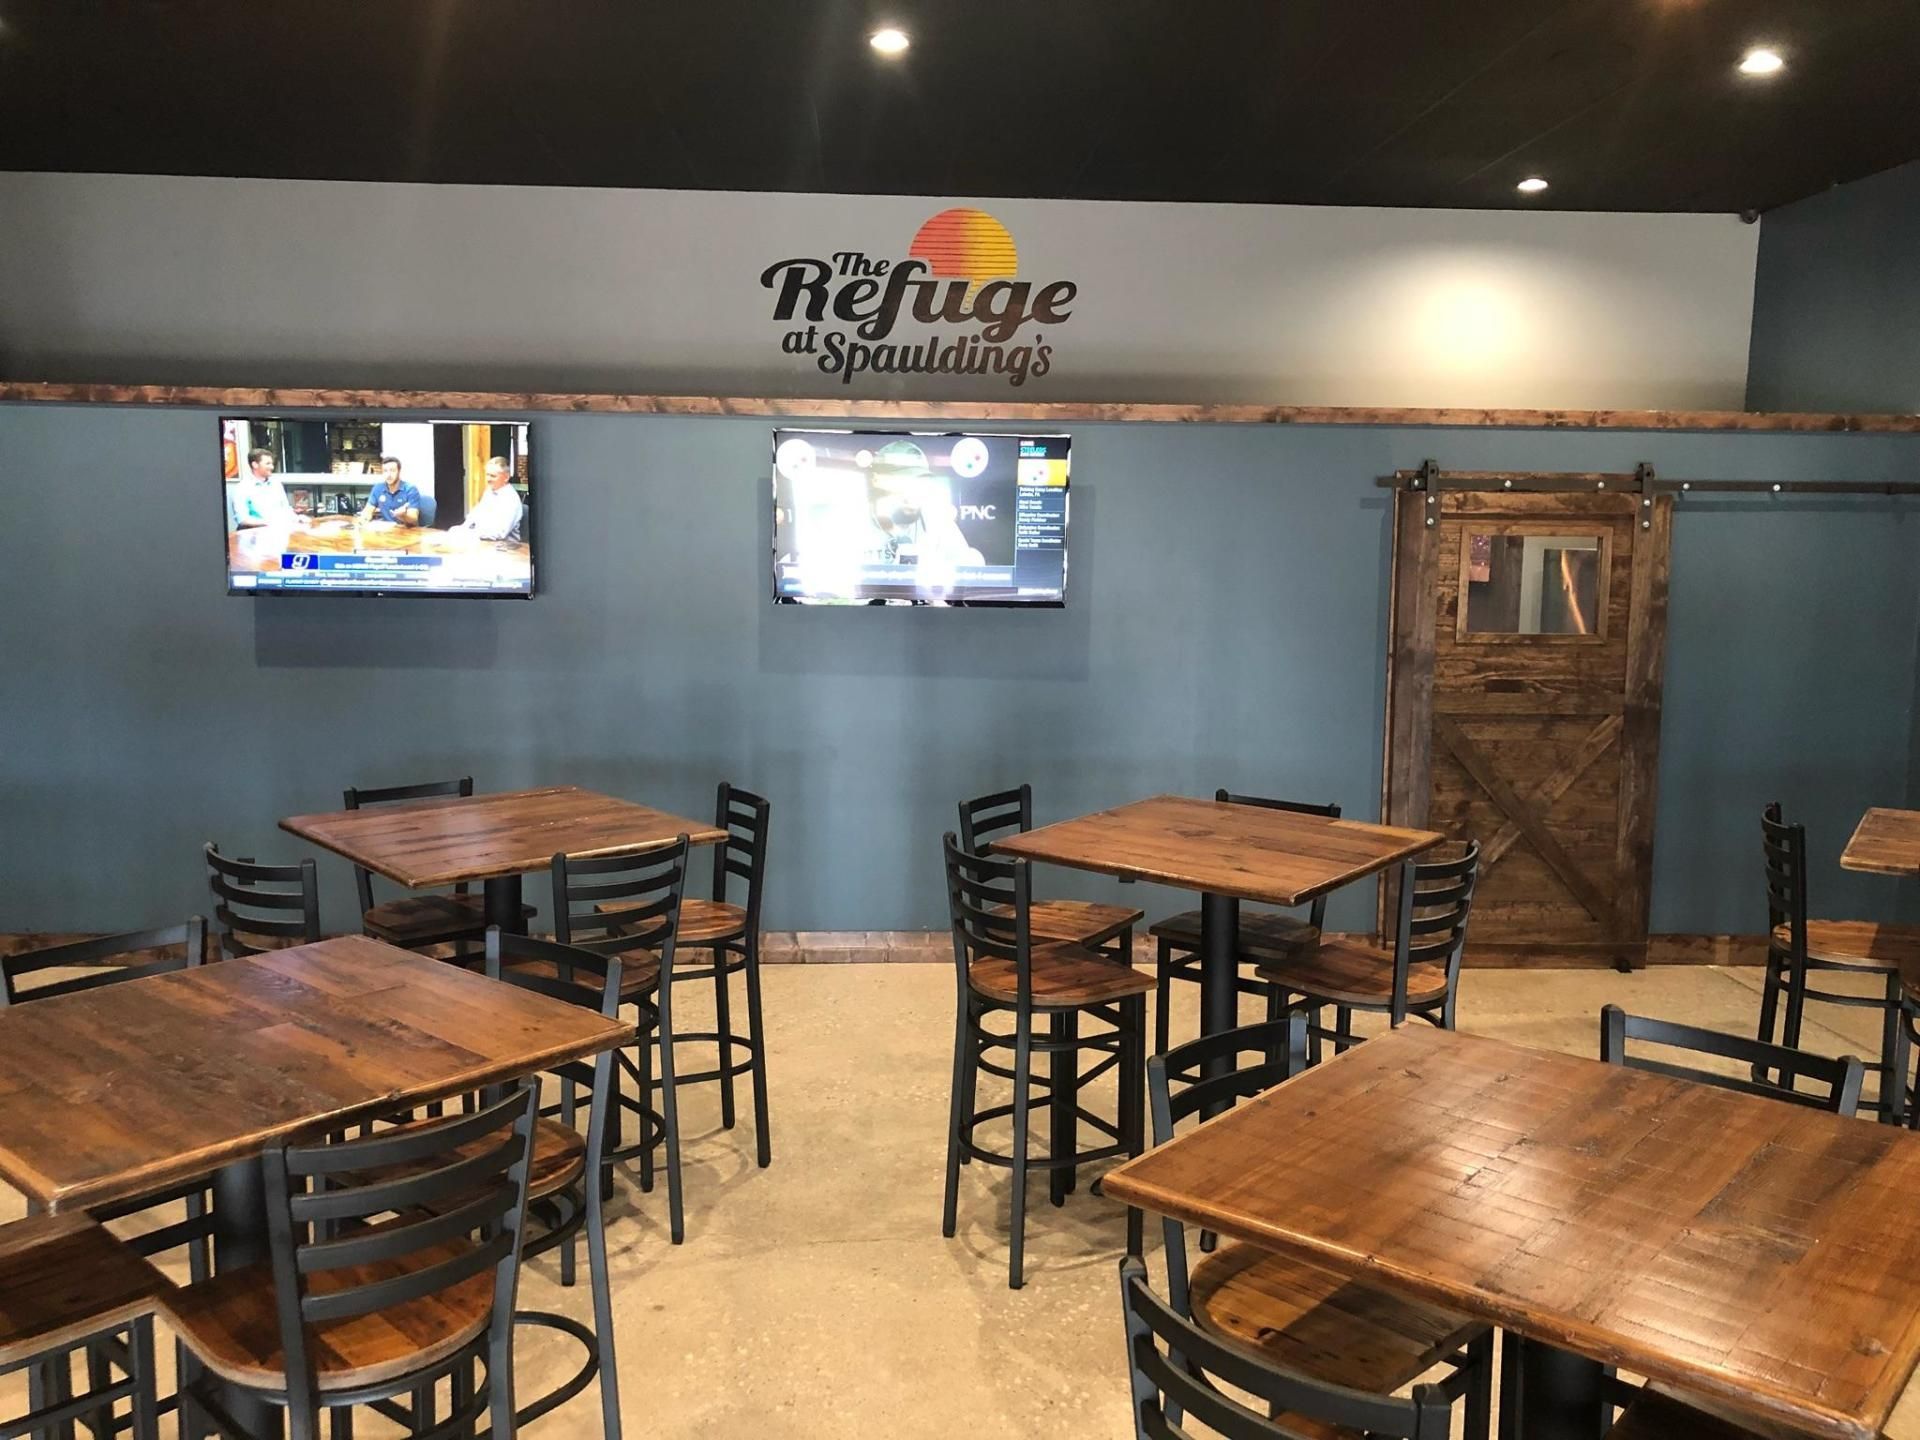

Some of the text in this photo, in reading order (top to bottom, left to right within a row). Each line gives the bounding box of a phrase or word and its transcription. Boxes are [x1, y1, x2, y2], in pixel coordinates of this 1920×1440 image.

[833, 252, 889, 277] The
[760, 258, 1077, 343] Refuge
[781, 325, 1053, 388] at Spaulding's
[960, 505, 996, 520] PNC
